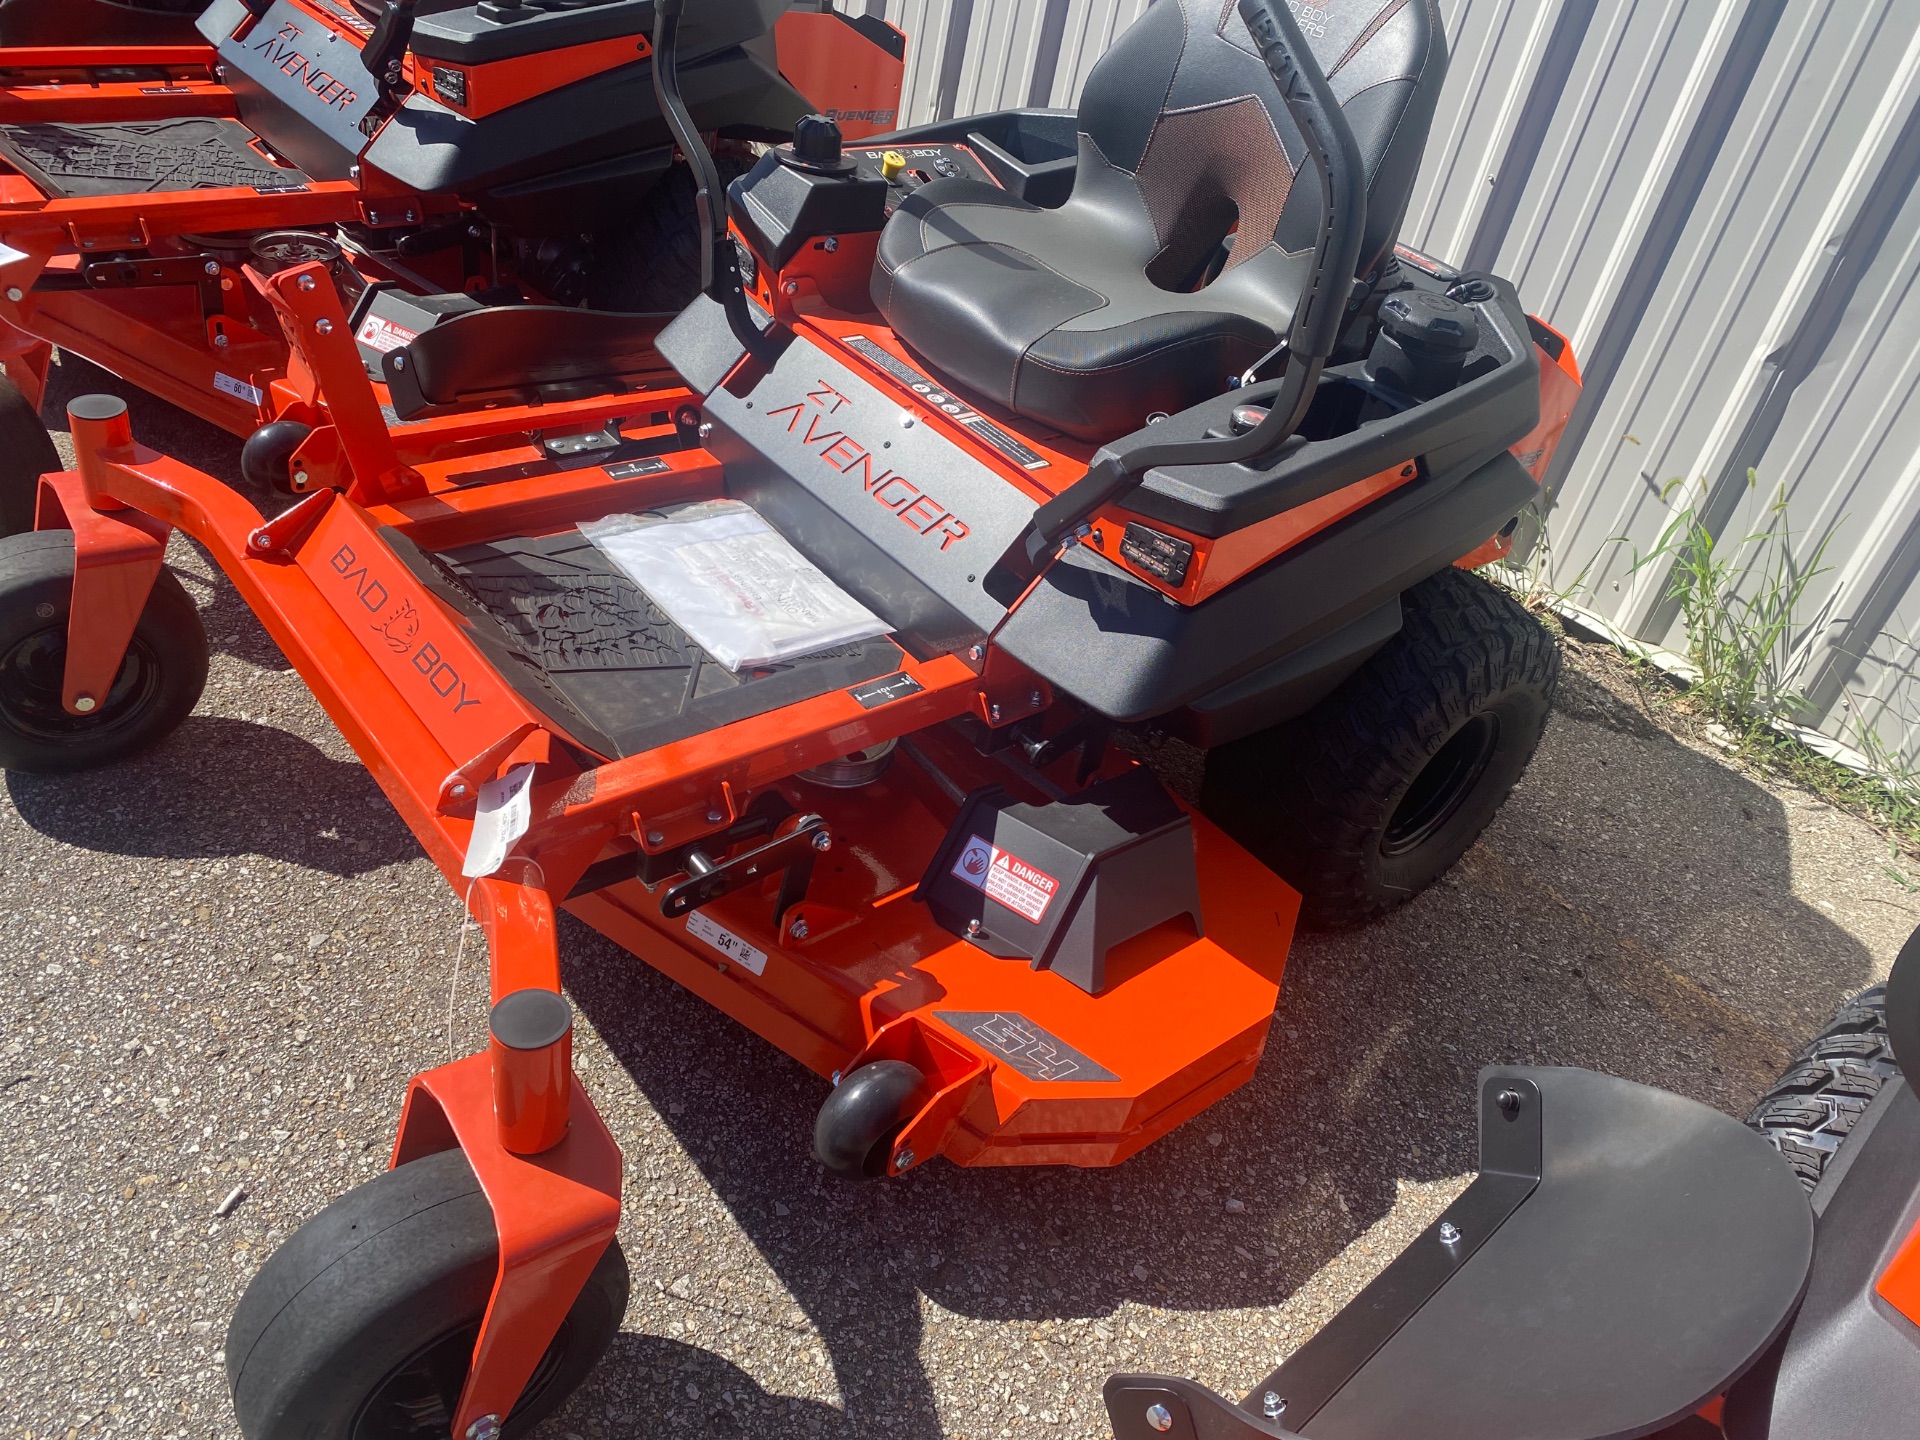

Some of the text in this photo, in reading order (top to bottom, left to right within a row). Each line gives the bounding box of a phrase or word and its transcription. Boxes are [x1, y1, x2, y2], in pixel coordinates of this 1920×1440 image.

[1302, 6, 1335, 25] BOY
[278, 21, 303, 42] ZT
[253, 38, 358, 112] AVENGER
[912, 149, 941, 157] BOY
[806, 379, 853, 415] ZT
[766, 402, 970, 553] AVENGER
[330, 543, 482, 714] BAD BOY
[1004, 874, 1018, 884] HANDS
[1007, 882, 1026, 895] OPERATE
[1011, 862, 1054, 893] DANGER
[718, 933, 738, 950] 54"
[972, 1013, 1080, 1081] 54
